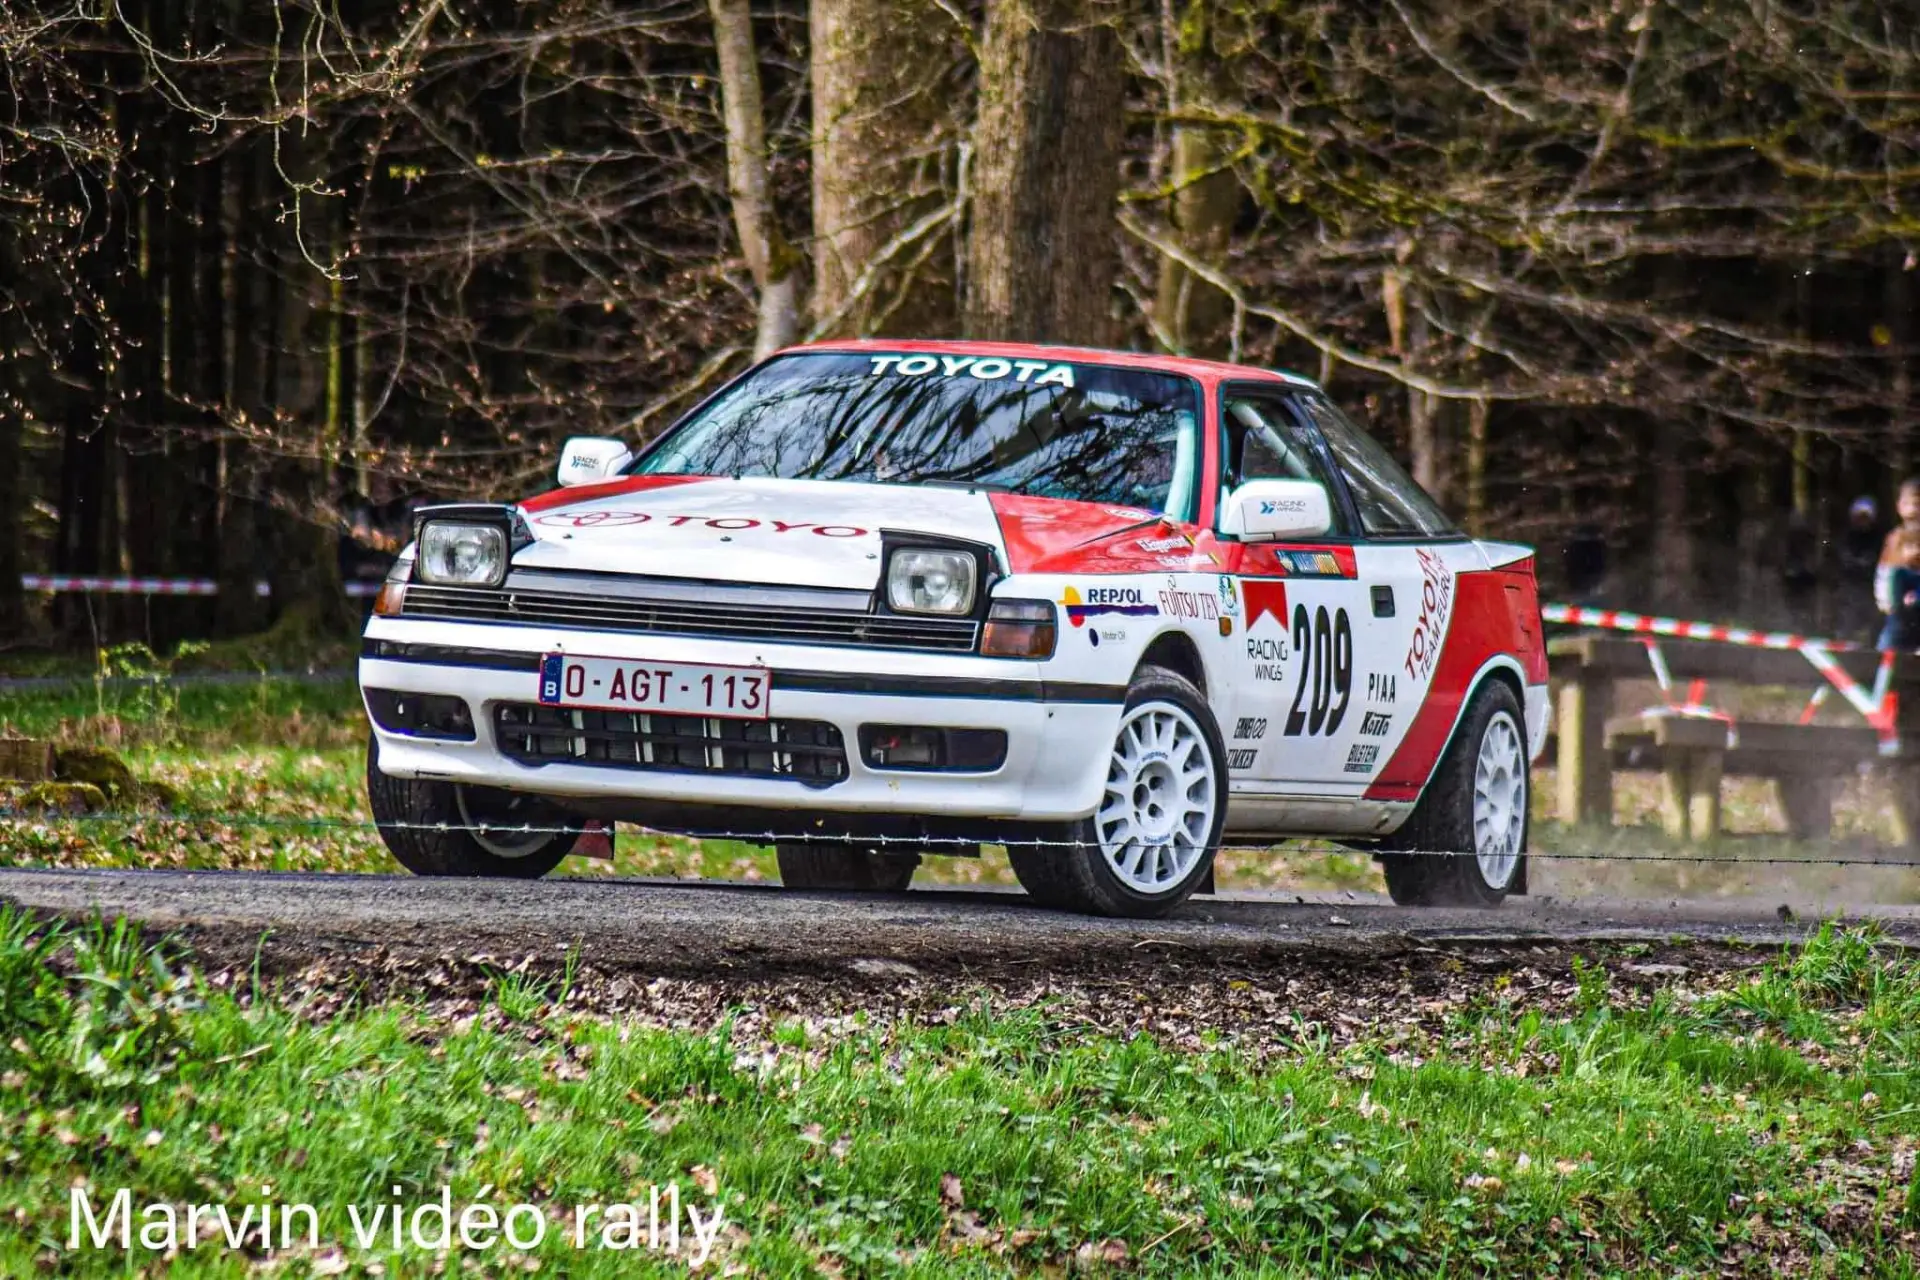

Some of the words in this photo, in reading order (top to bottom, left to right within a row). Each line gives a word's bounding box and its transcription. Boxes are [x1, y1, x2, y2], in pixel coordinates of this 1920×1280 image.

[870, 355, 1075, 388] TOYOTA
[667, 514, 877, 537] TOYO
[1087, 588, 1144, 604] REPSOL
[1158, 589, 1199, 623] FUJITSU
[1405, 548, 1438, 680] TOYOTA
[1247, 638, 1288, 661] RACING
[1420, 620, 1440, 681] TEAM
[1254, 664, 1284, 682] WINGS
[1283, 603, 1352, 737] 209
[544, 681, 557, 697] B
[1367, 672, 1396, 704] PIAA
